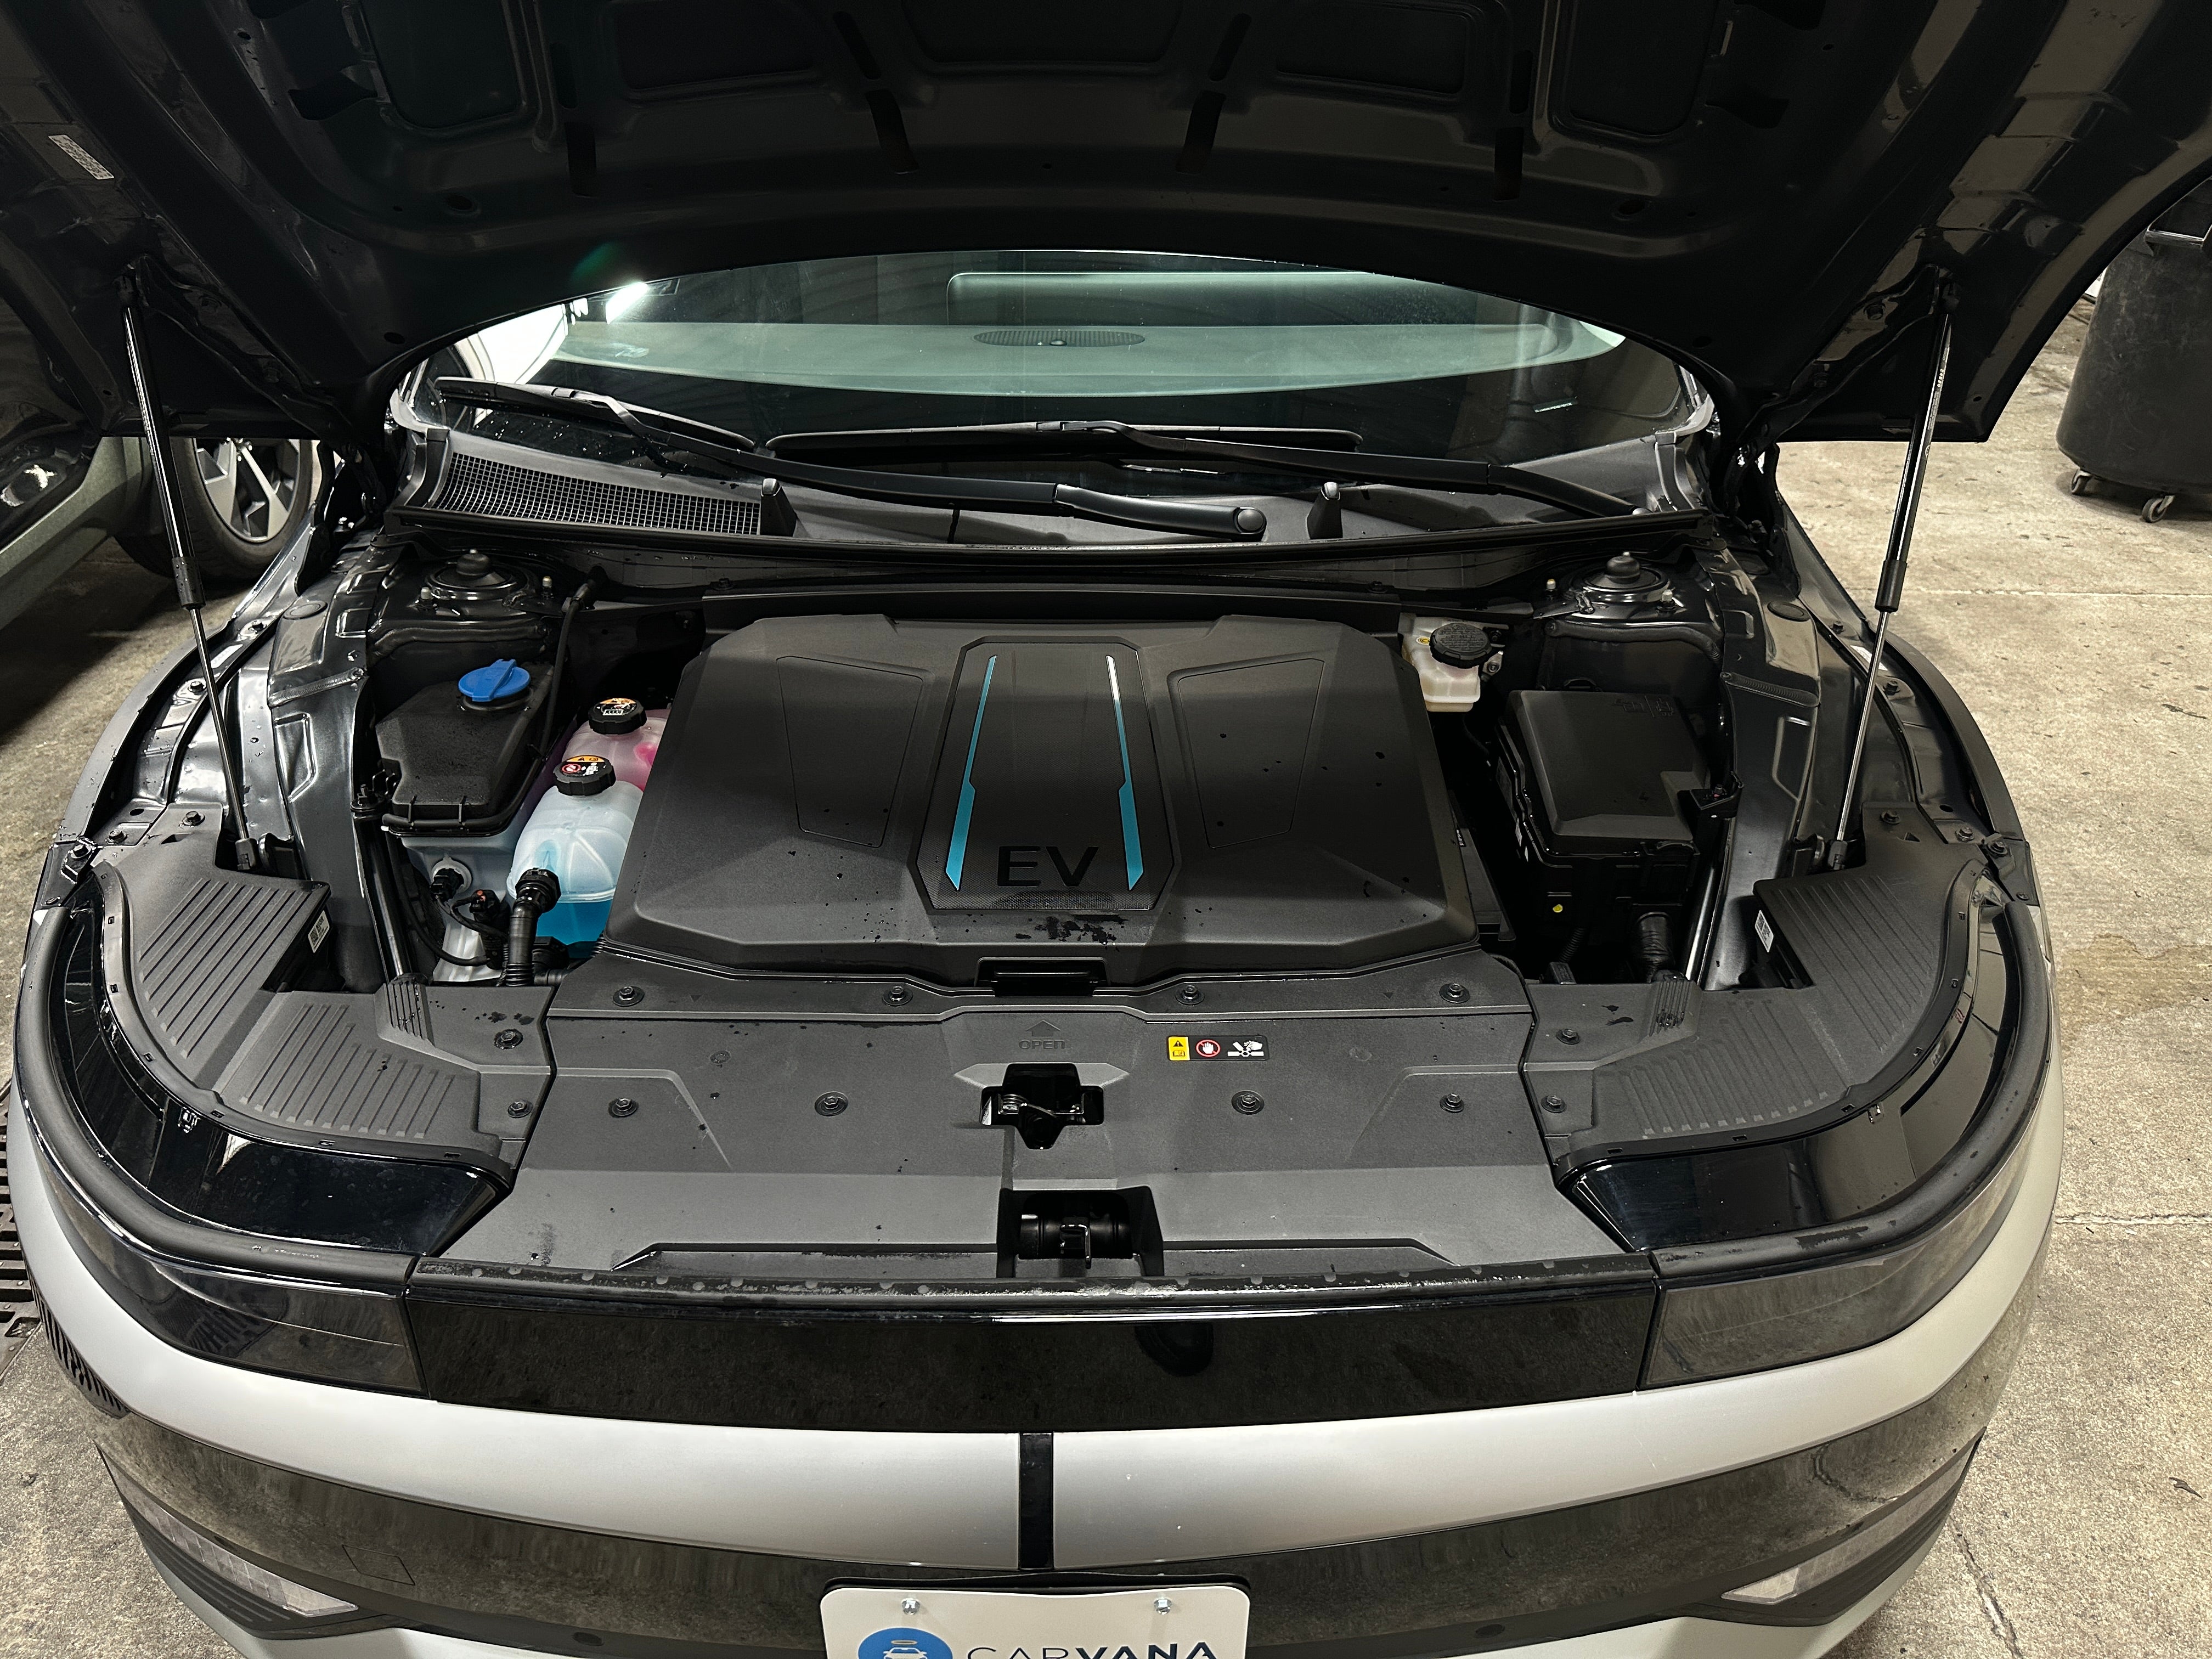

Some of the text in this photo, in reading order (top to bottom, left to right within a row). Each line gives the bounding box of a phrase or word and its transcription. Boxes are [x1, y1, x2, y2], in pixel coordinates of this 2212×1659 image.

[997, 845, 1099, 887] EV
[1019, 1039, 1065, 1049] OPEN
[967, 1642, 1217, 1659] CARVANA
